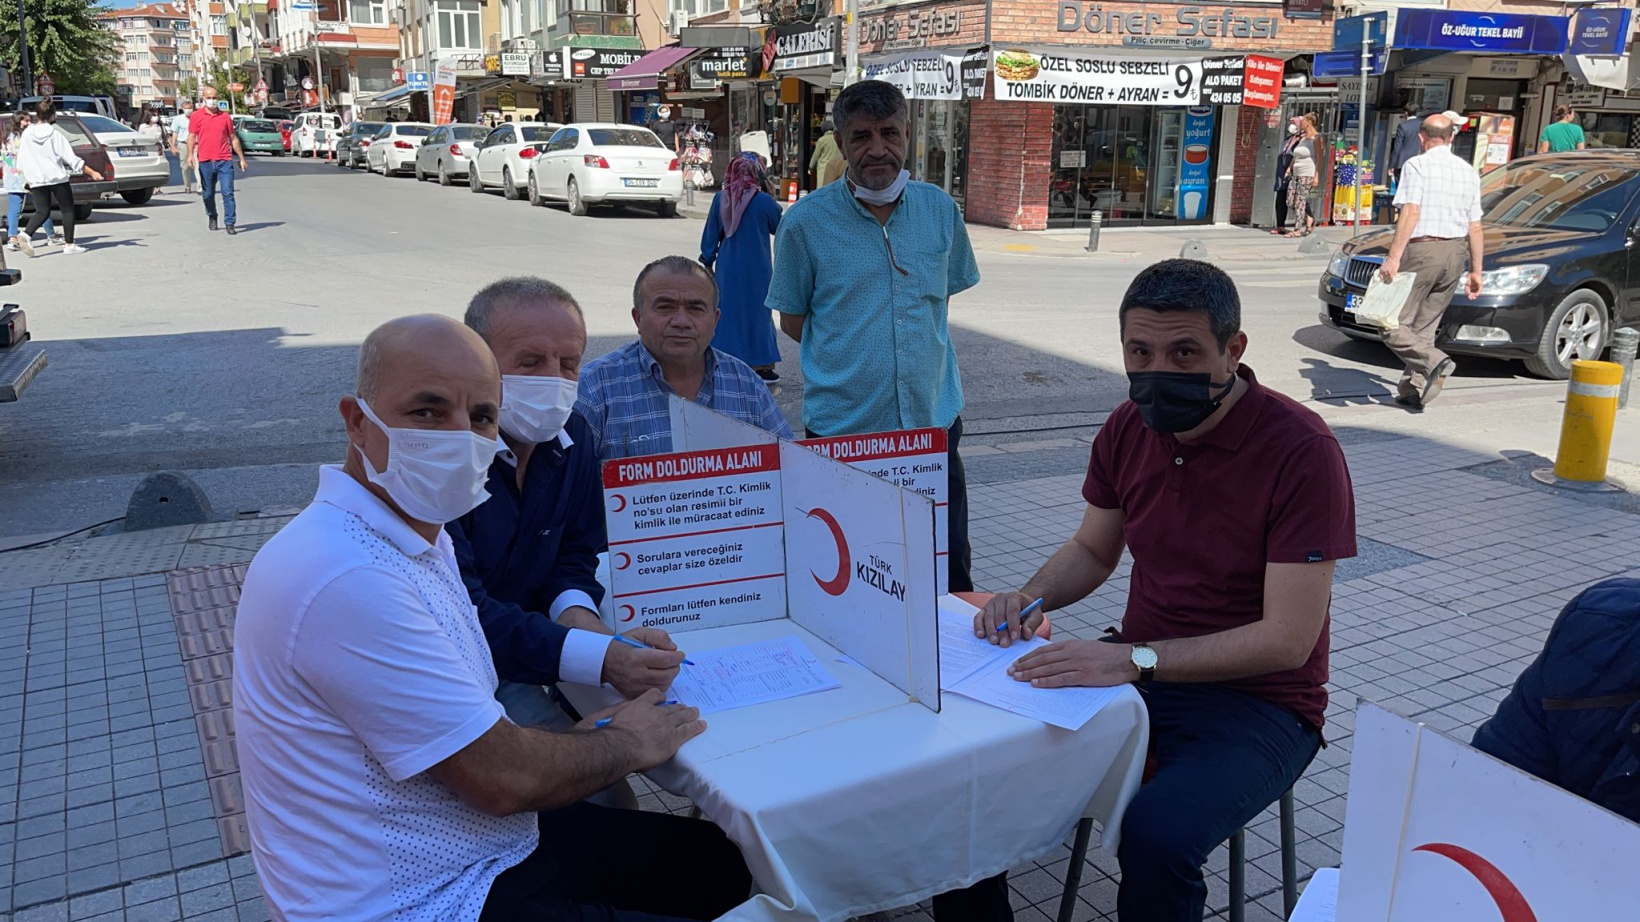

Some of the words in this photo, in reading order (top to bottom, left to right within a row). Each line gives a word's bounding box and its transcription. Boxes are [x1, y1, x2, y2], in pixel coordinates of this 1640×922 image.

[859, 15, 902, 44] Döner
[908, 6, 960, 39] Sefası
[1057, 1, 1162, 35] Döner
[1176, 6, 1279, 39] Sefası
[1441, 23, 1477, 37] ÖZ-UĞUR
[1477, 26, 1501, 38] TEKEL
[1131, 36, 1147, 46] Piliç
[1150, 37, 1181, 46] çevirme
[1185, 38, 1205, 47] Ciğer
[590, 67, 602, 75] CEP
[604, 67, 621, 75] TEL
[702, 57, 747, 72] marlet
[1040, 53, 1072, 72] ÖZEL
[1076, 58, 1115, 74] SOSLU
[1120, 60, 1169, 76] SEBZELİ
[1202, 59, 1224, 69] Döner
[1205, 75, 1219, 86] ALO
[1221, 75, 1243, 86] PAKET
[1341, 83, 1374, 91] SAYIAL
[1007, 80, 1056, 99] TOMBİK
[1060, 82, 1105, 101] DÖNER
[1117, 86, 1160, 102] AYRAN
[1210, 92, 1222, 104] 424
[1223, 92, 1232, 104] 05
[1232, 92, 1242, 104] 05
[1186, 128, 1211, 139] yoğurt
[1183, 178, 1205, 187] ayran
[833, 437, 896, 459] DOLDURMA
[898, 433, 933, 452] ALANI
[619, 461, 653, 482] FORM
[656, 454, 724, 478] DOLDURMA
[726, 450, 762, 470] ALANI
[891, 466, 910, 476] T.C.
[912, 462, 943, 474] Kimlik
[902, 477, 916, 487] bir
[632, 493, 666, 506] Lütfen
[669, 488, 715, 502] üzerinde
[717, 485, 736, 496] T.C.
[739, 481, 771, 493] Kimlik
[915, 487, 936, 496] iniz
[665, 503, 689, 514] olan
[728, 497, 743, 507] bir
[634, 518, 666, 531] kimlik
[668, 514, 681, 526] ile
[684, 510, 732, 525] müracaat
[734, 506, 765, 519] ediniz
[636, 551, 682, 564] Sorulara
[684, 542, 743, 557] vereceğiniz
[637, 561, 683, 576] cevaplar
[685, 557, 706, 569] size
[708, 554, 743, 567] özeldir
[869, 554, 892, 575] TÜRK
[856, 561, 906, 602] KIZILAY
[640, 603, 685, 617] Formları
[687, 599, 716, 611] lütfen
[719, 592, 762, 606] kendiniz
[642, 612, 701, 628] doldurunuz
